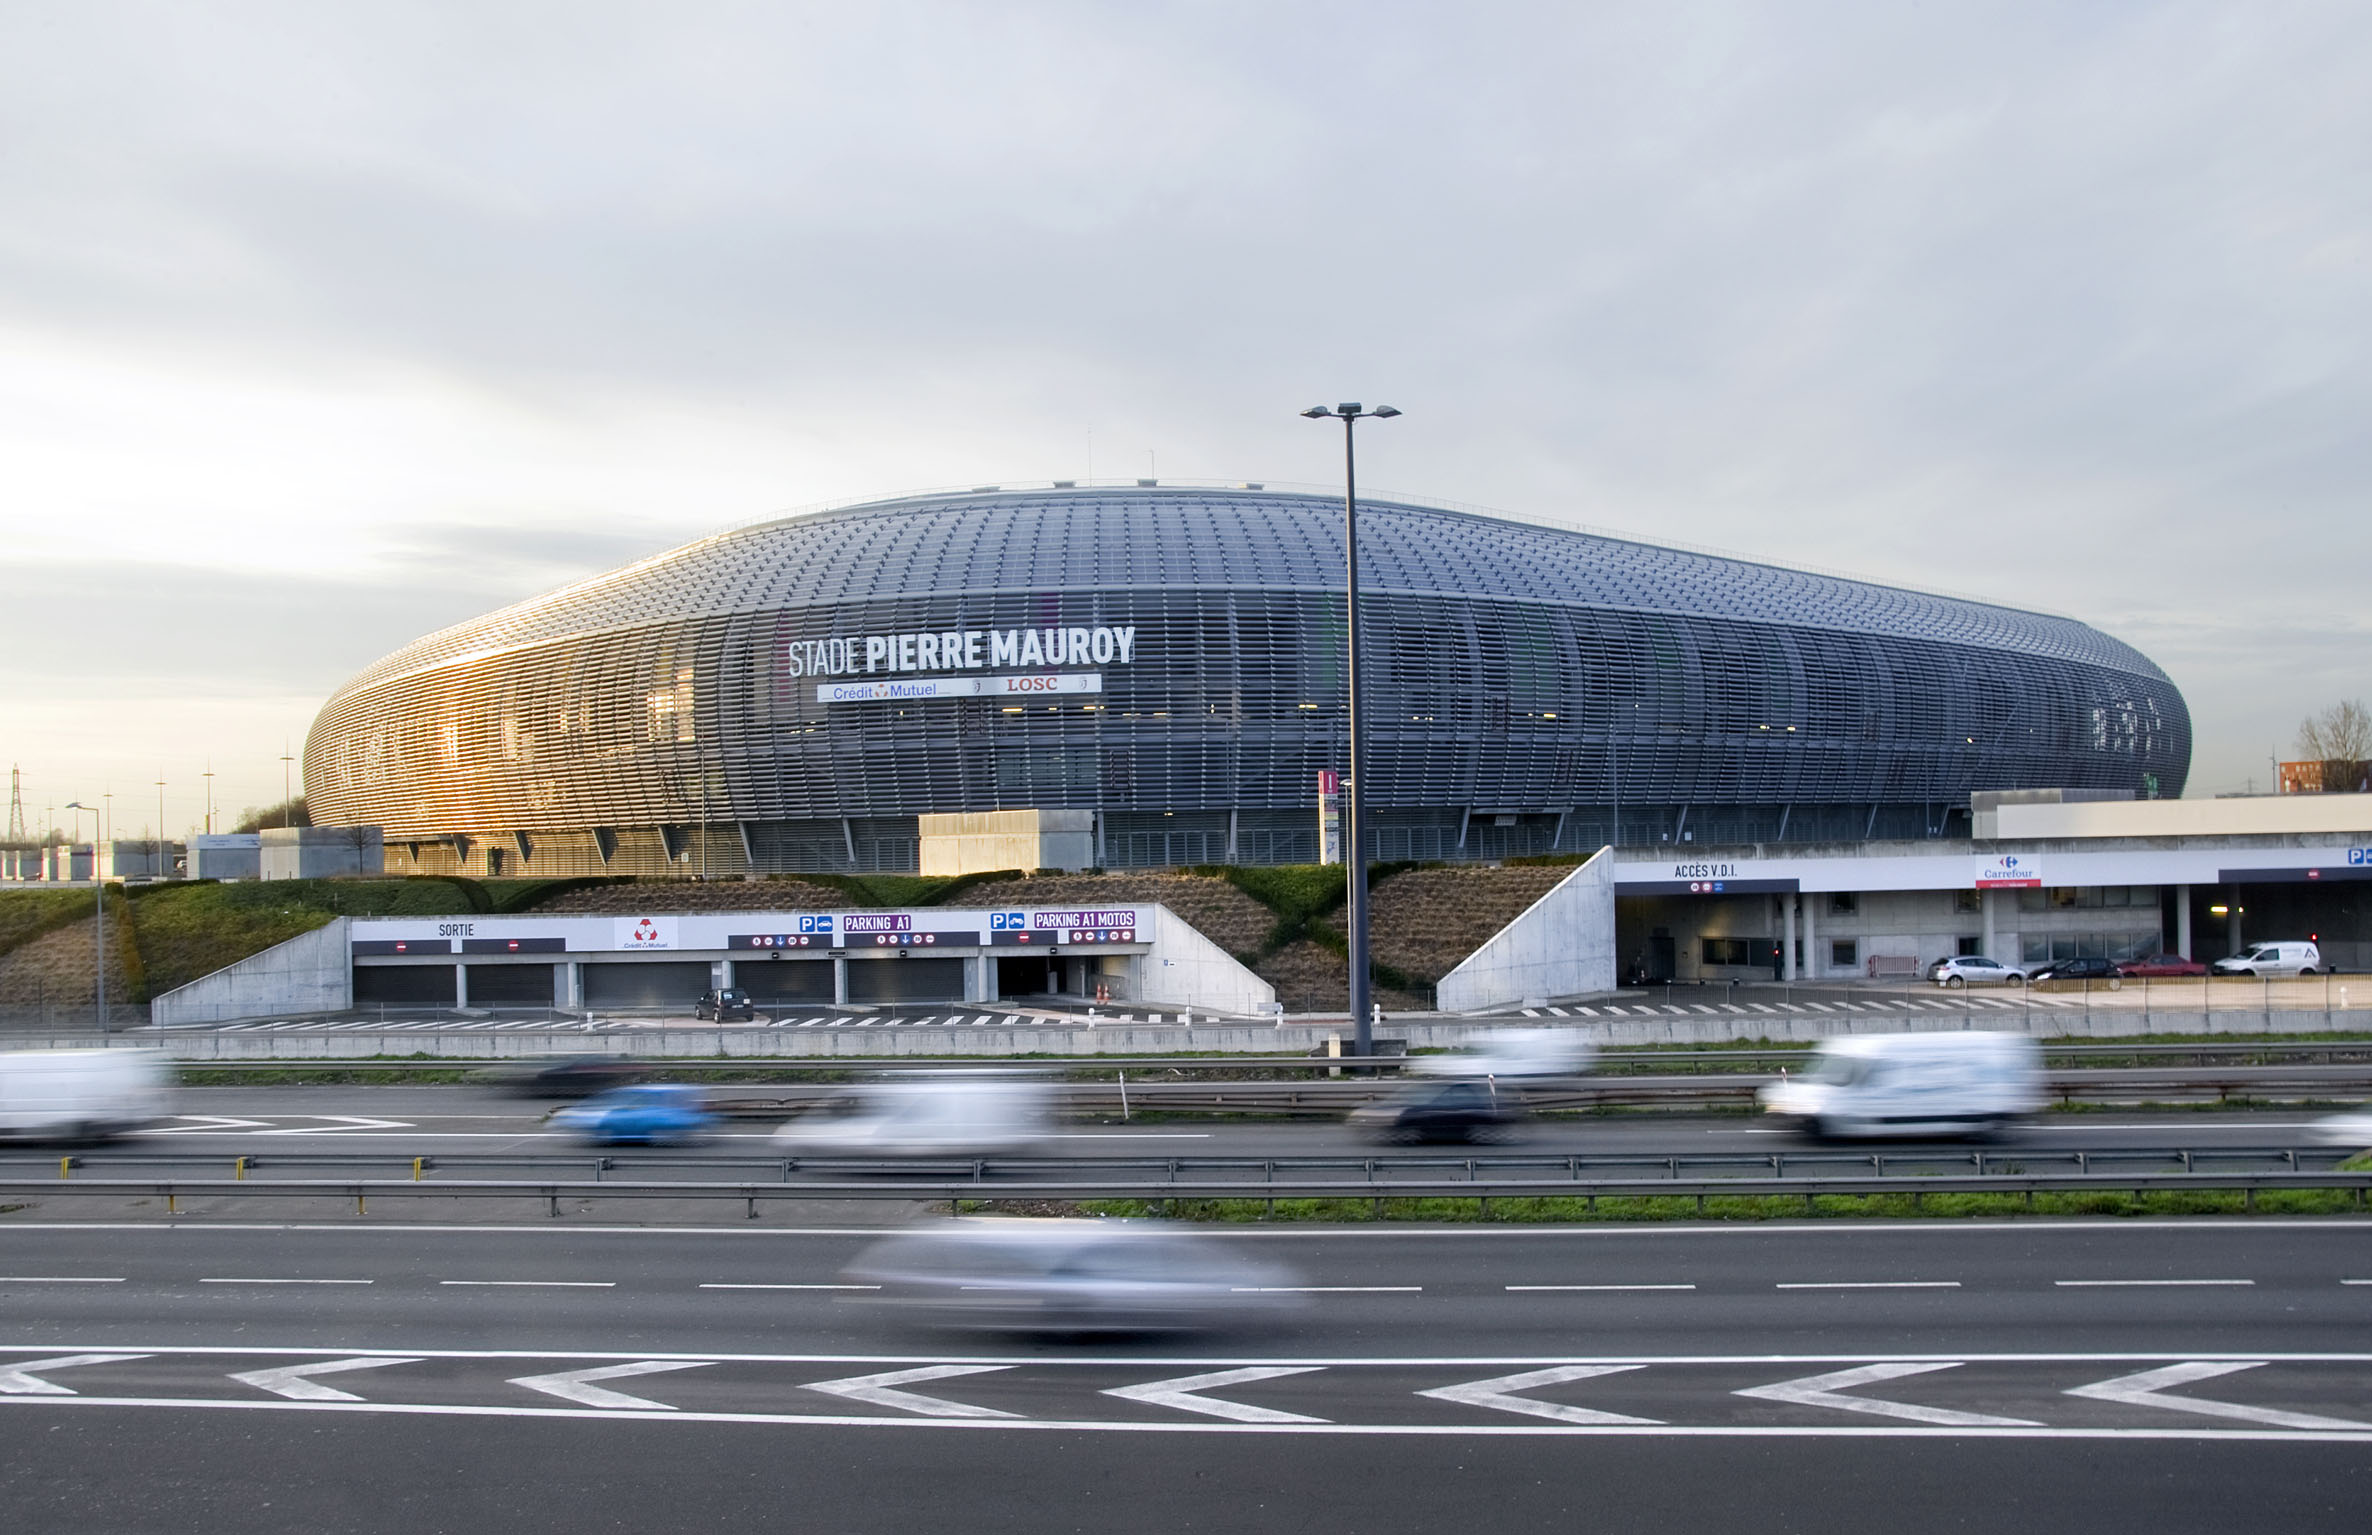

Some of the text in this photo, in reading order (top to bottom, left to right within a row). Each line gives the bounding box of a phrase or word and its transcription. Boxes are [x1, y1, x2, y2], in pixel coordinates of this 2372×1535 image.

[789, 626, 1136, 677] STADE PIERRE MAUROY
[1007, 677, 1058, 691] LOSC
[834, 683, 937, 700] Crédit Mutuel
[2351, 850, 2362, 863] P
[1675, 861, 1737, 877] ACCÈS V.D.I.
[1984, 869, 2033, 879] Carrefour
[802, 918, 813, 931] P
[845, 916, 910, 930] PARKING A1
[993, 915, 1004, 928] P
[1036, 912, 1134, 927] PARKING A1 MOTOS
[439, 924, 474, 937] SORTIE
